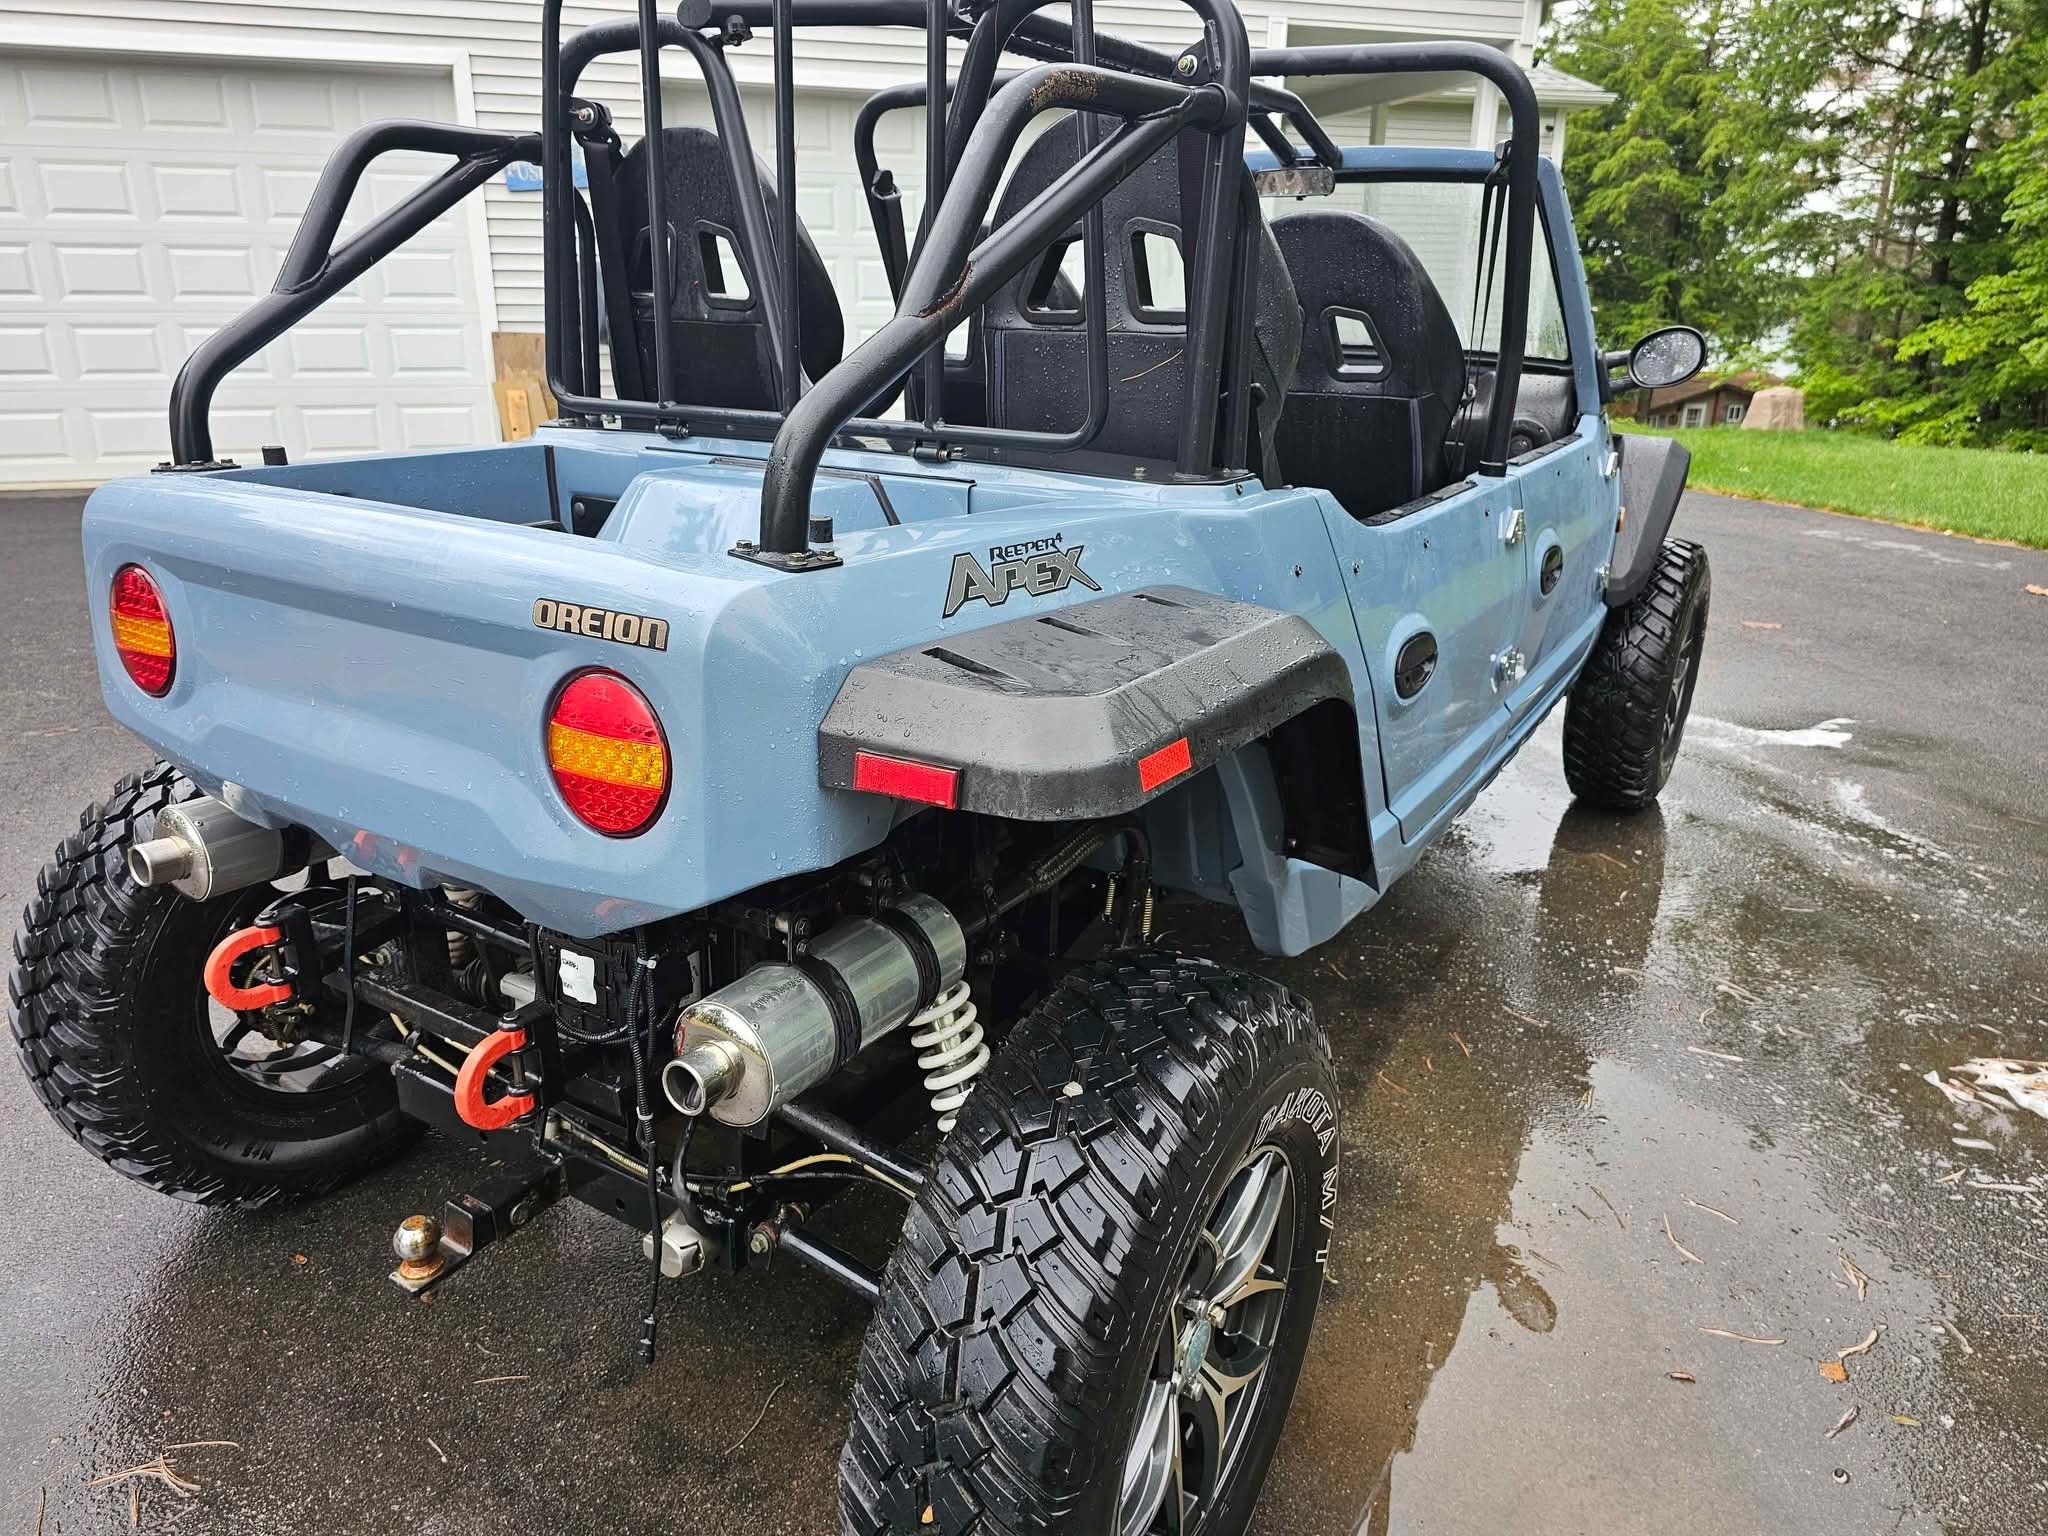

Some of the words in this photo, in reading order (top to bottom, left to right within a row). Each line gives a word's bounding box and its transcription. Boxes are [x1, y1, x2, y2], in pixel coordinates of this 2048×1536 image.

[942, 545, 1102, 619] APEX
[533, 599, 669, 650] OREION
[1251, 1087, 1336, 1157] DAKOTA
